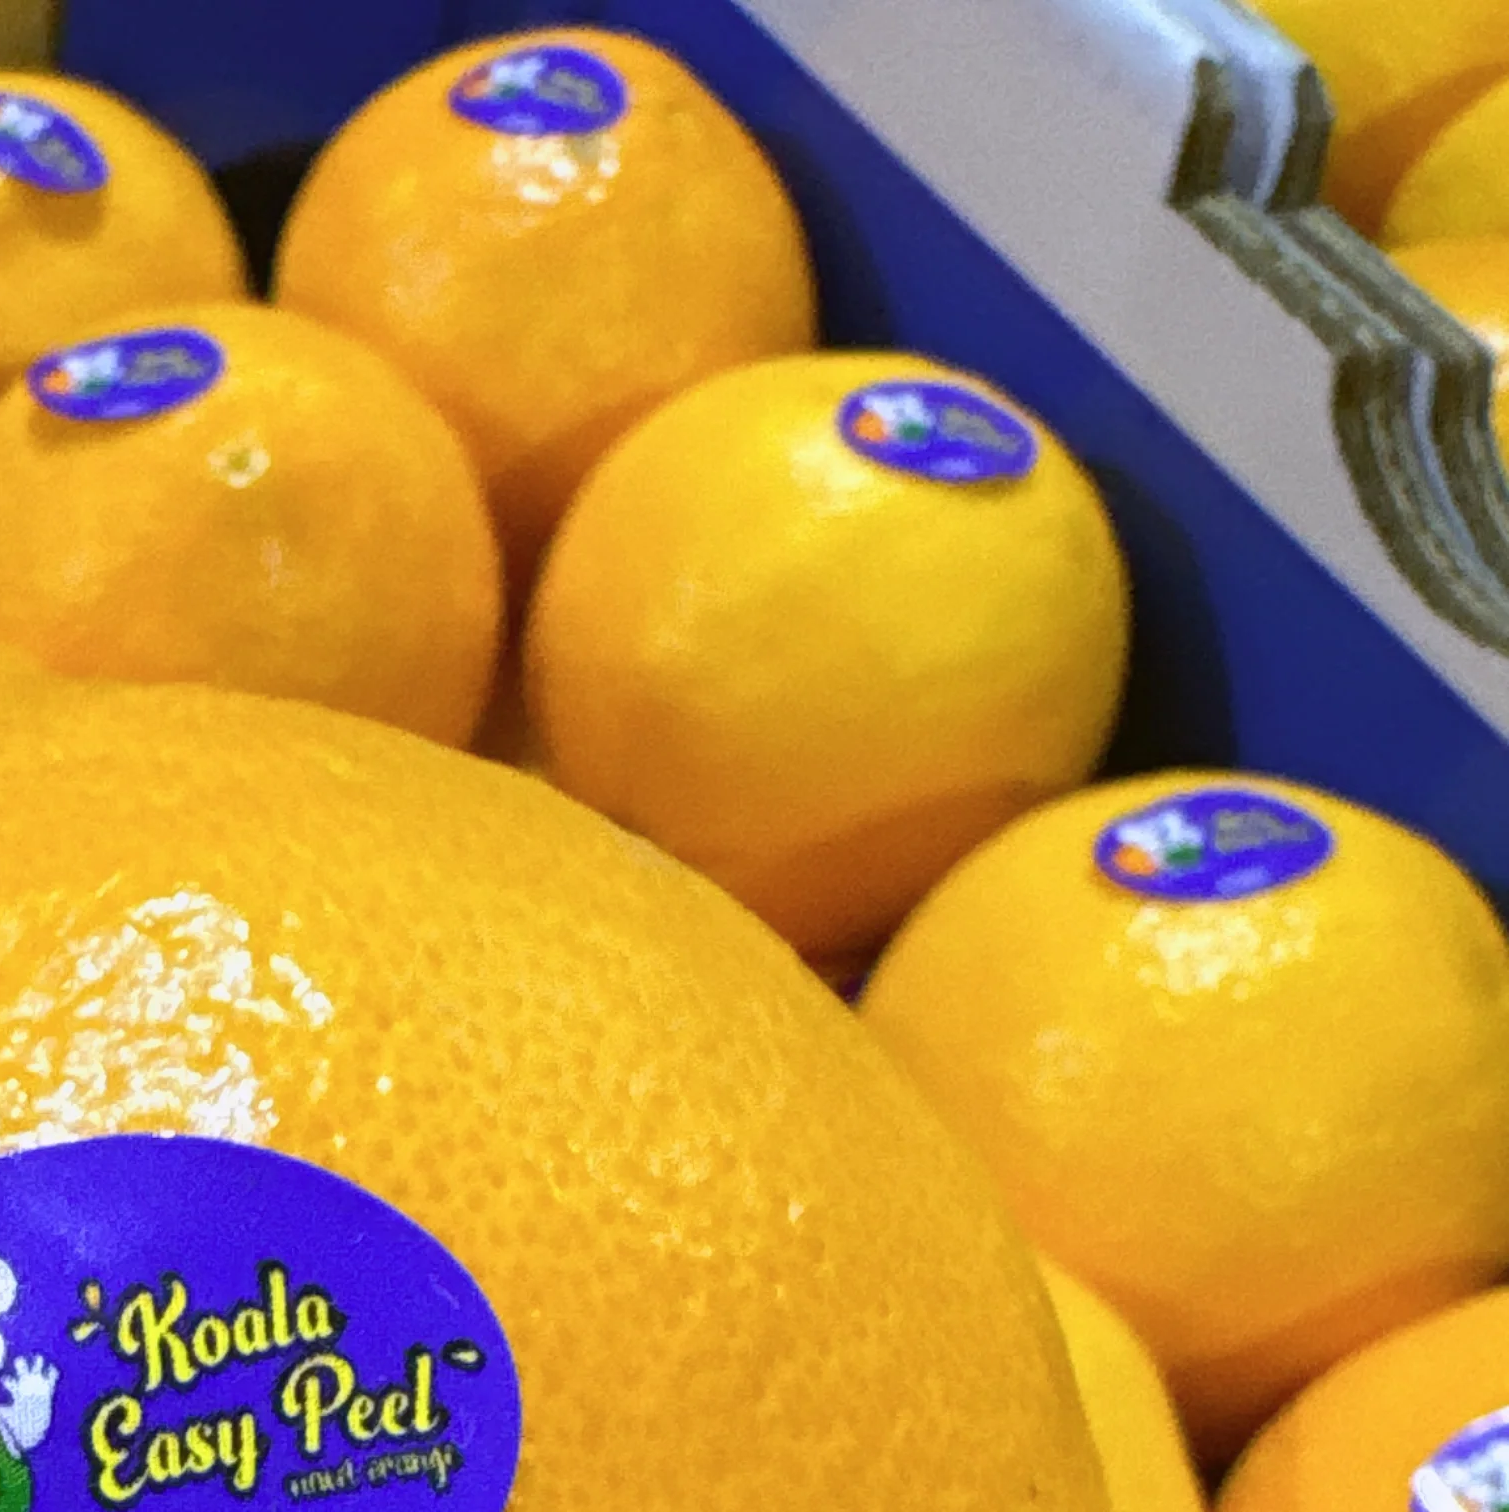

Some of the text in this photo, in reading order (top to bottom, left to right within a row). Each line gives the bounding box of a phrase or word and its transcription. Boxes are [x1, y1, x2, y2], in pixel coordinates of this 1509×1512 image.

[116, 1266, 336, 1393] Koala
[88, 1394, 263, 1502] Easy
[279, 1352, 445, 1455] Peel
